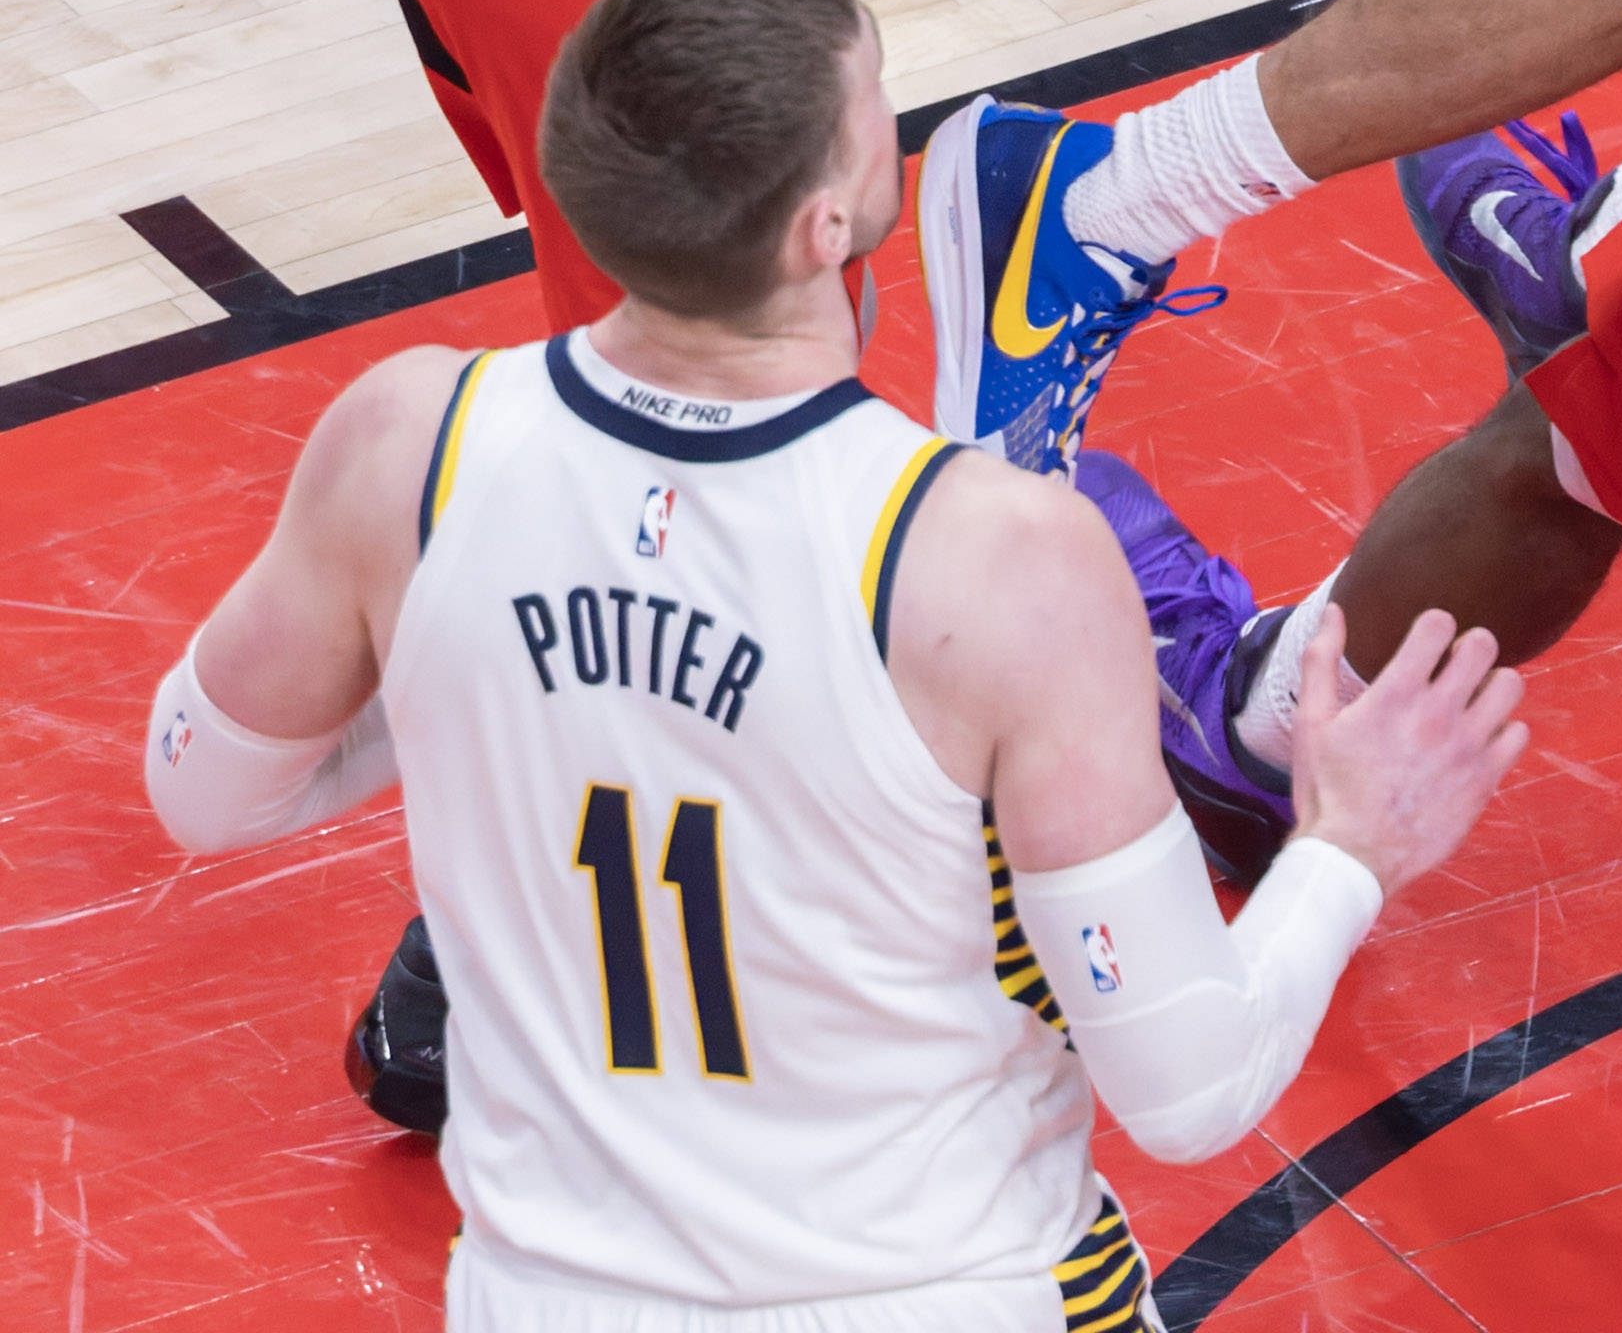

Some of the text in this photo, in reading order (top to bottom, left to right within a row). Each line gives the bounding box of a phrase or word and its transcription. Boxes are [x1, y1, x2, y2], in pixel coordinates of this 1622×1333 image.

[620, 385, 732, 424] NIKE PRO
[512, 586, 765, 733] POTTER
[570, 780, 756, 1083] 11
